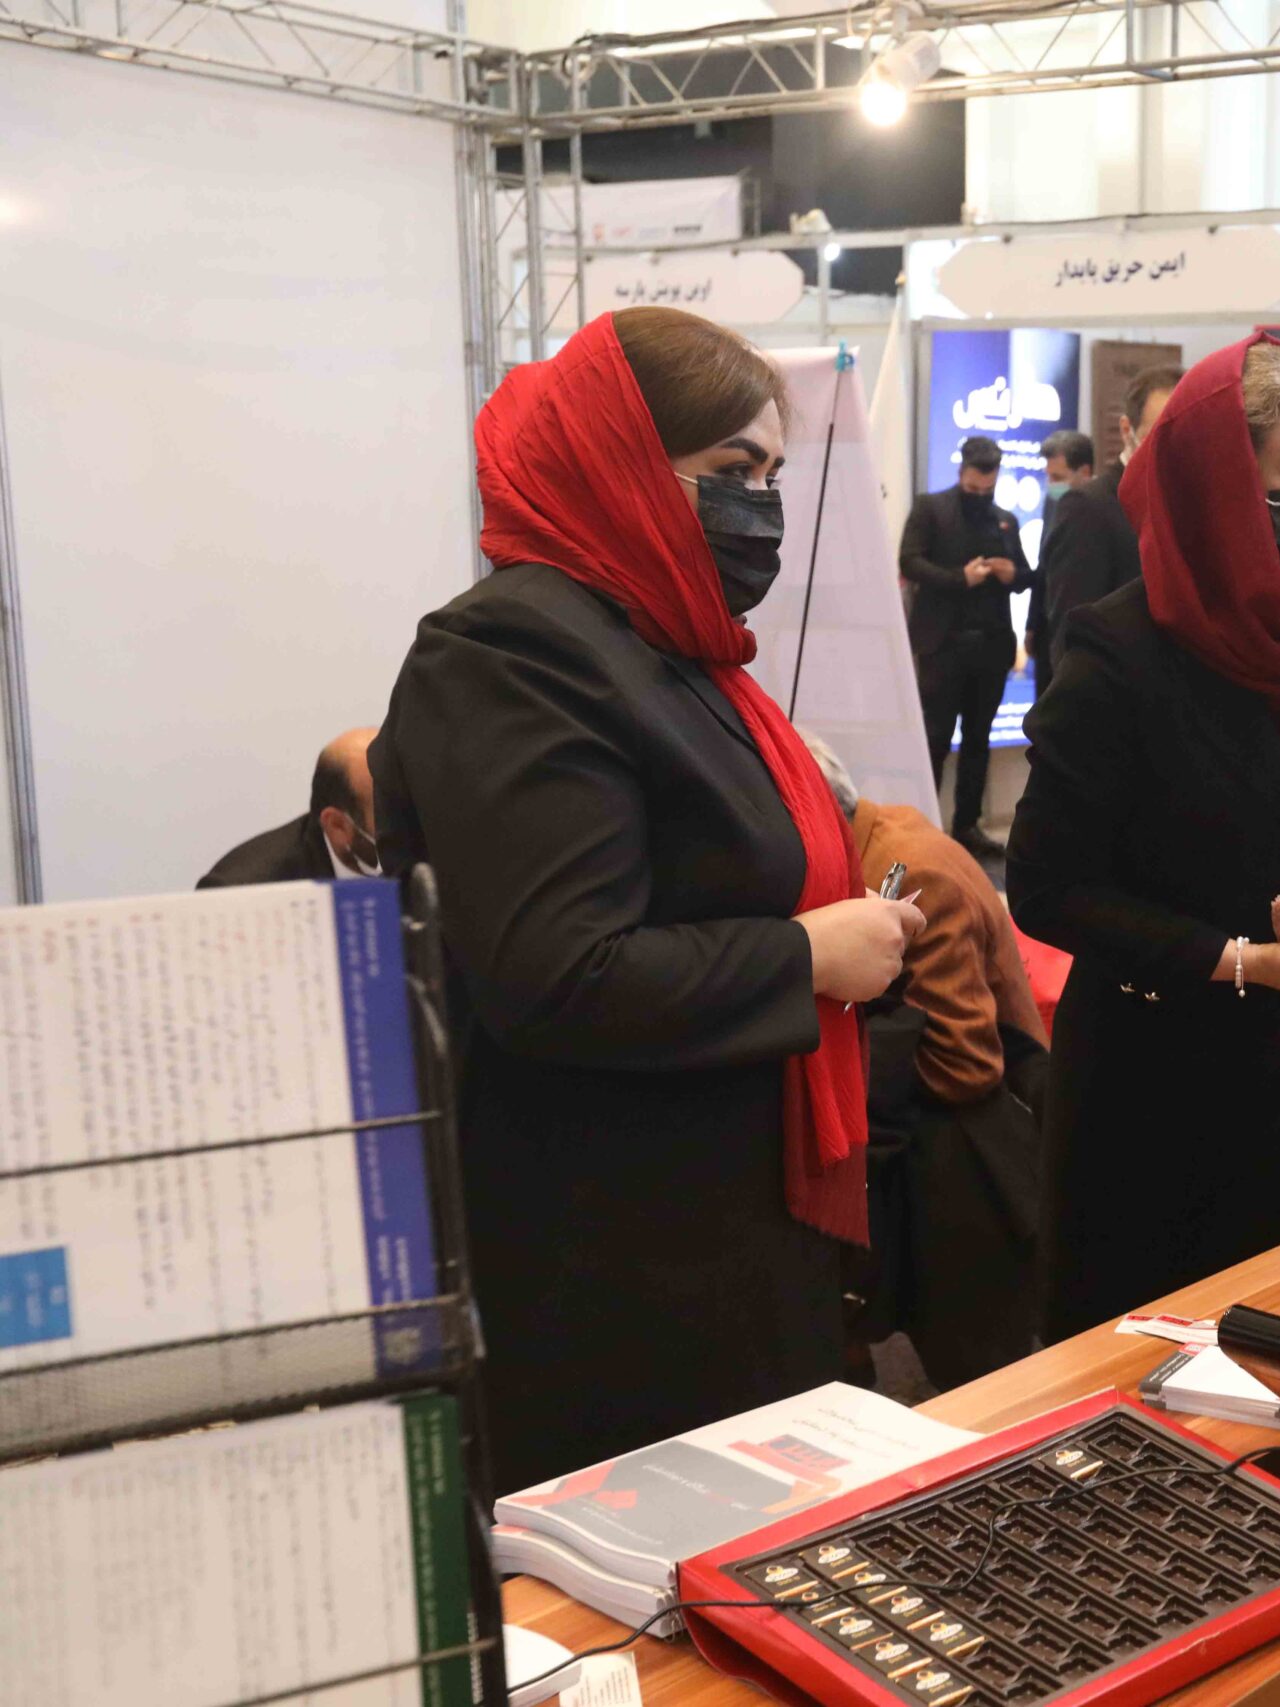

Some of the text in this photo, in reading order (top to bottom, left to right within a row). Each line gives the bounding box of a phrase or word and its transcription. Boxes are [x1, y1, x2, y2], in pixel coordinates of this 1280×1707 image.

[1054, 251, 1186, 288] ایمن حریق پایدار
